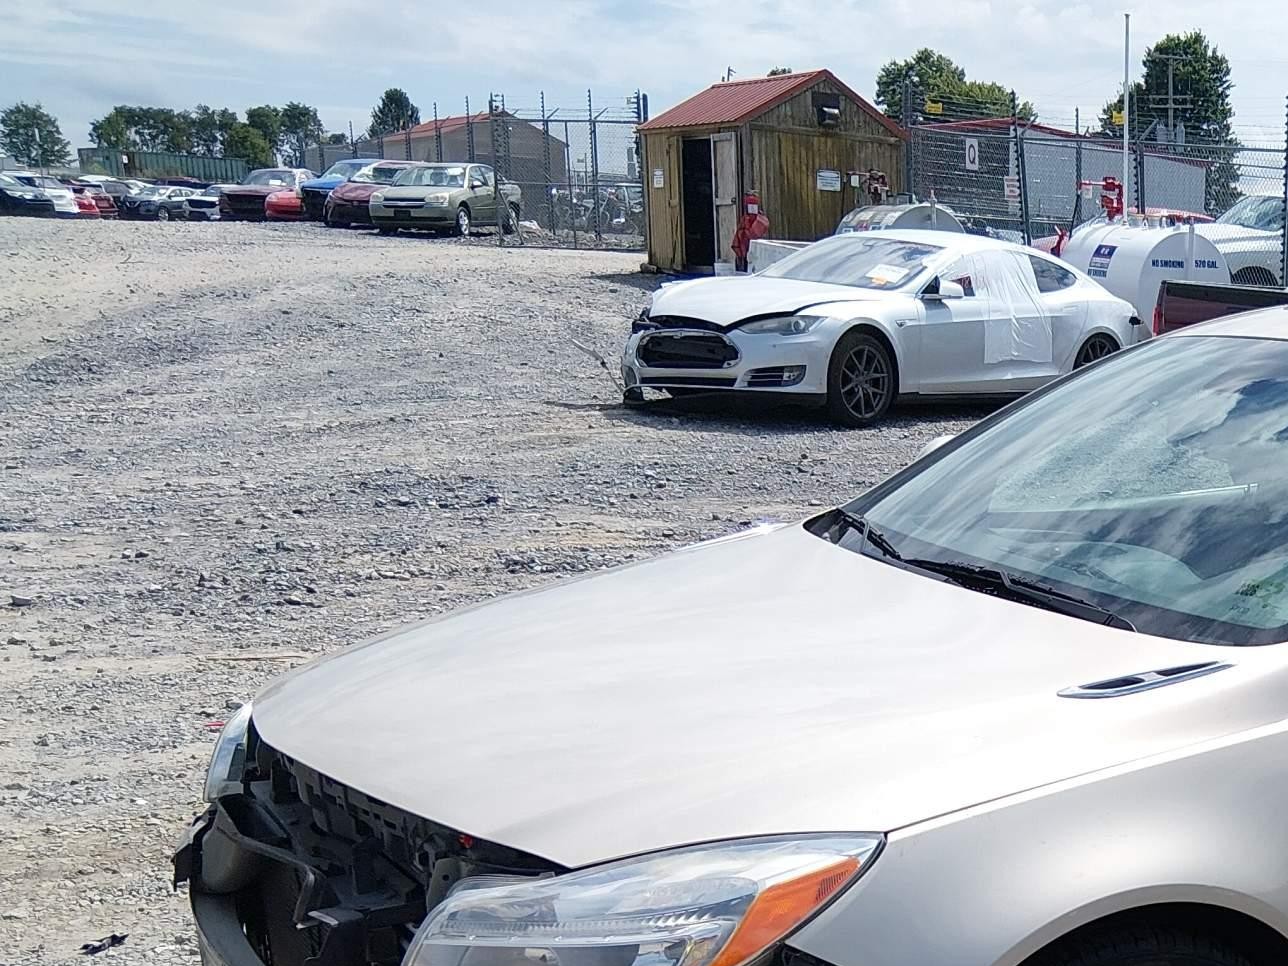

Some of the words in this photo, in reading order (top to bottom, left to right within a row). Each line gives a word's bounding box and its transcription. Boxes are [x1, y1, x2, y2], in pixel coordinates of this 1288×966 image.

[968, 144, 976, 165] Q
[1151, 259, 1159, 268] NO
[1160, 260, 1184, 269] SMOKING
